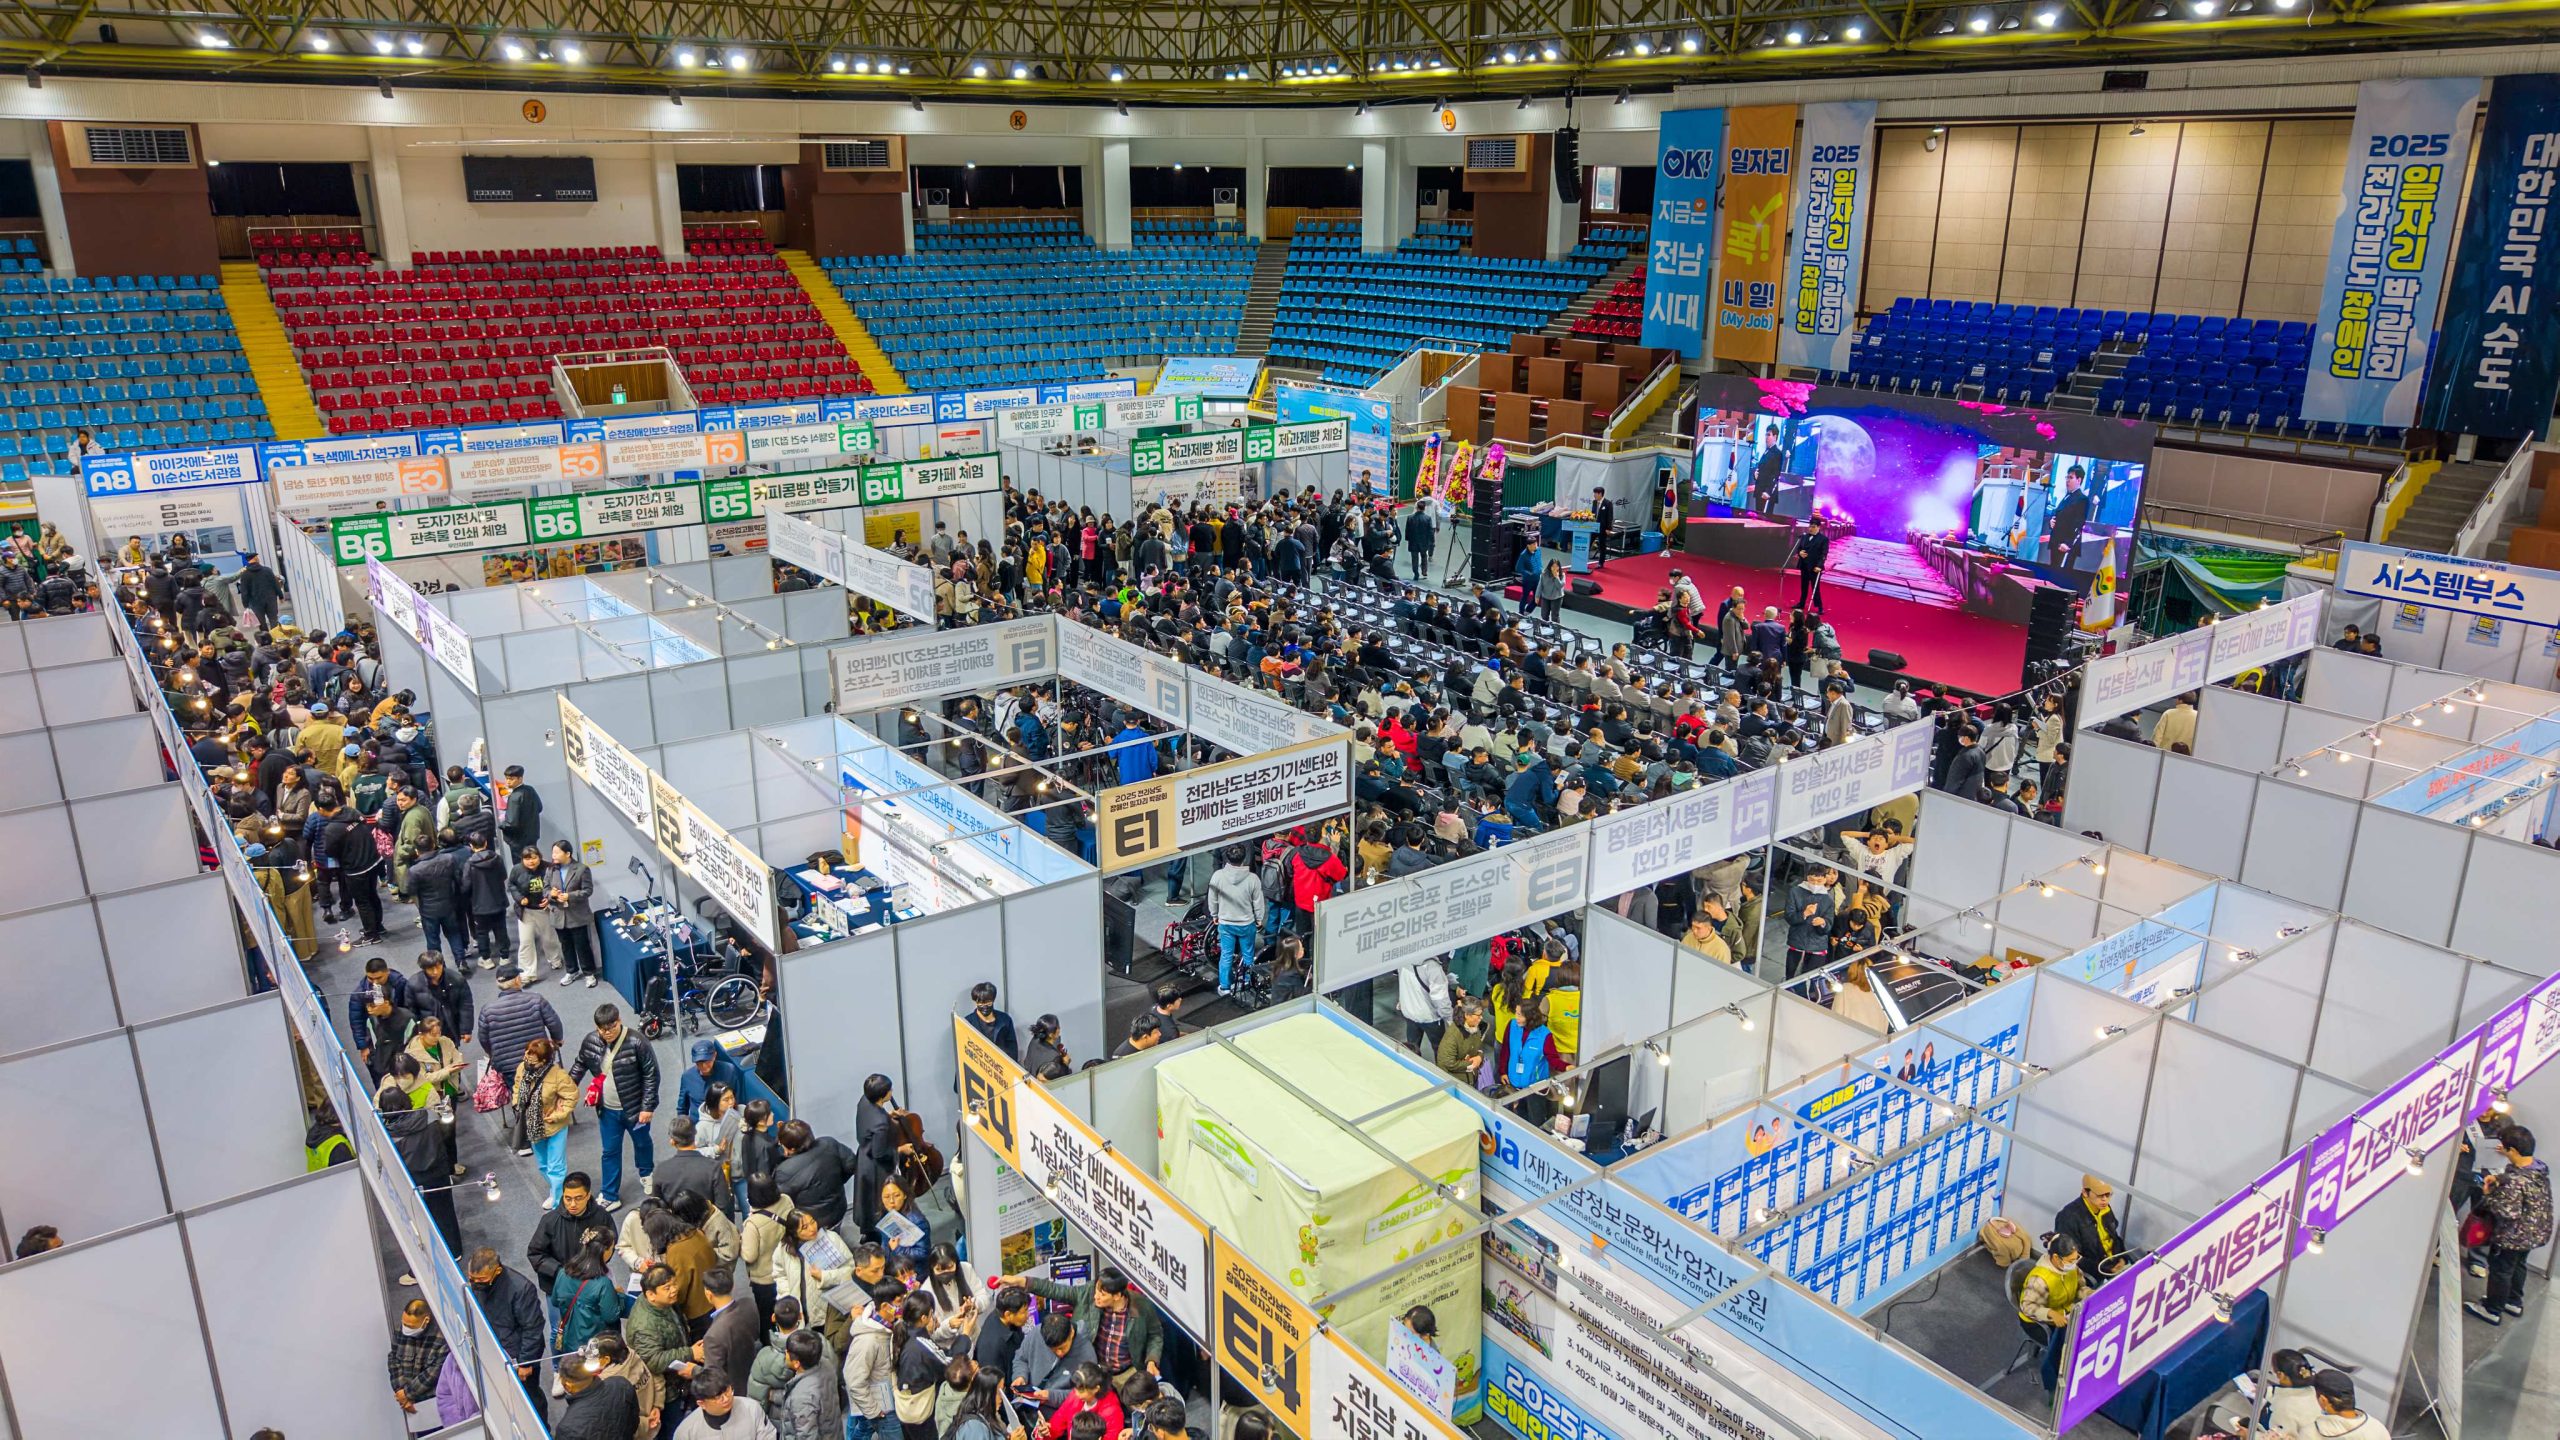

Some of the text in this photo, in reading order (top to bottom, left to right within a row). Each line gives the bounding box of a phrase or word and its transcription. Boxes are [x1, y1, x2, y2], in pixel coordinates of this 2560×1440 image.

[1014, 115, 1023, 126] K
[1662, 146, 1714, 179] OK!
[1730, 147, 1790, 176] 일자리
[1811, 145, 1861, 163] 2025
[2368, 133, 2451, 158] 2025
[1658, 198, 1708, 225] 지금은
[1654, 240, 1705, 277] 전남
[1797, 168, 1831, 335] 전라남도 장애인
[1817, 167, 1858, 336] 일자리 박람회
[2473, 132, 2560, 391] 대한민국 AI 수도
[2329, 164, 2399, 380] 전라남도 장애인
[2364, 164, 2444, 382] 일자리 박람회
[1649, 291, 1700, 330] 시대
[1723, 280, 1776, 310] 내 일!
[1721, 309, 1774, 331] (My Job)
[939, 404, 965, 419] A2
[608, 423, 695, 440] 순천장애인보호작업장
[1167, 438, 1238, 460] 제과제빵 체험
[1247, 439, 1273, 458] B2
[1279, 427, 1343, 446] 제과제빵 체험
[149, 453, 239, 471] 아이갓에브리씽
[312, 445, 412, 463] 녹색에너지연구원
[1133, 451, 1162, 472] B2
[90, 469, 132, 492] A8
[152, 467, 242, 485] 이순신도서관점
[753, 481, 811, 501] 커피콩빵
[813, 477, 856, 495] 만들기
[865, 477, 901, 501] B4
[918, 464, 984, 485] 홈카페 체험
[417, 509, 498, 529] 도자기전시 및
[598, 503, 685, 525] 판촉물 인쇄 체험
[603, 491, 677, 510] 도자기전시 및
[708, 493, 749, 518] B5
[410, 523, 508, 546] 판촉물 인쇄 체험
[534, 512, 578, 538] B6
[337, 532, 387, 560] B6
[2372, 562, 2525, 611] 시스템부스
[594, 757, 631, 802] 보조공학기기
[630, 787, 643, 813] 전시
[605, 741, 645, 794] 근로자를 위한
[1186, 750, 1339, 804] 전라남도보조기기센터와
[1110, 792, 1168, 812] 장애인 일자리 박람회
[1115, 785, 1163, 803] 2025 전라남도
[1181, 770, 1342, 826] 함께하는 휠체어 E-스포츠
[657, 804, 684, 862] E2
[1114, 809, 1159, 857] E1
[1221, 799, 1306, 831] 전라남도보조기기센터
[688, 816, 763, 896] 장애인 근로자를 위한
[695, 846, 741, 897] 보조공학기기
[742, 885, 760, 918] 전시
[2469, 1033, 2518, 1112] F5
[963, 1062, 1014, 1153] E4
[2344, 1061, 2470, 1191] 간접채용관
[1053, 1122, 1084, 1168] 전남
[1086, 1150, 1154, 1231] 메타버스
[1029, 1130, 1088, 1205] 지원센터
[1091, 1189, 1125, 1236] 홍보
[1128, 1221, 1147, 1255] 및
[1151, 1239, 1188, 1292] 체험
[2301, 1164, 2338, 1229] F6
[1578, 1270, 1604, 1292] 새로운
[1614, 1232, 1644, 1256] Culture
[1645, 1249, 1679, 1282] Industry
[1729, 1303, 1765, 1333] Agency
[2128, 1189, 2291, 1353] 간접채용관
[1225, 1270, 1300, 1342] 장애인 일자리 박람회
[1231, 1262, 1292, 1321] 2025 전라남도
[1222, 1289, 1301, 1416] E4
[2068, 1324, 2121, 1401] F6
[1575, 1365, 1598, 1389] 2025.
[1599, 1380, 1618, 1402] 10월
[1619, 1395, 1637, 1416] 기준
[1576, 1343, 1685, 1428] 14개 34개 체험 게임
[1586, 1327, 1707, 1420] 있으며 지역에 대한 스토리를
[1665, 1366, 1682, 1386] 전남
[1684, 1381, 1712, 1407] 관광지
[1348, 1373, 1397, 1438] 전남
[1505, 1363, 1580, 1440] 2025
